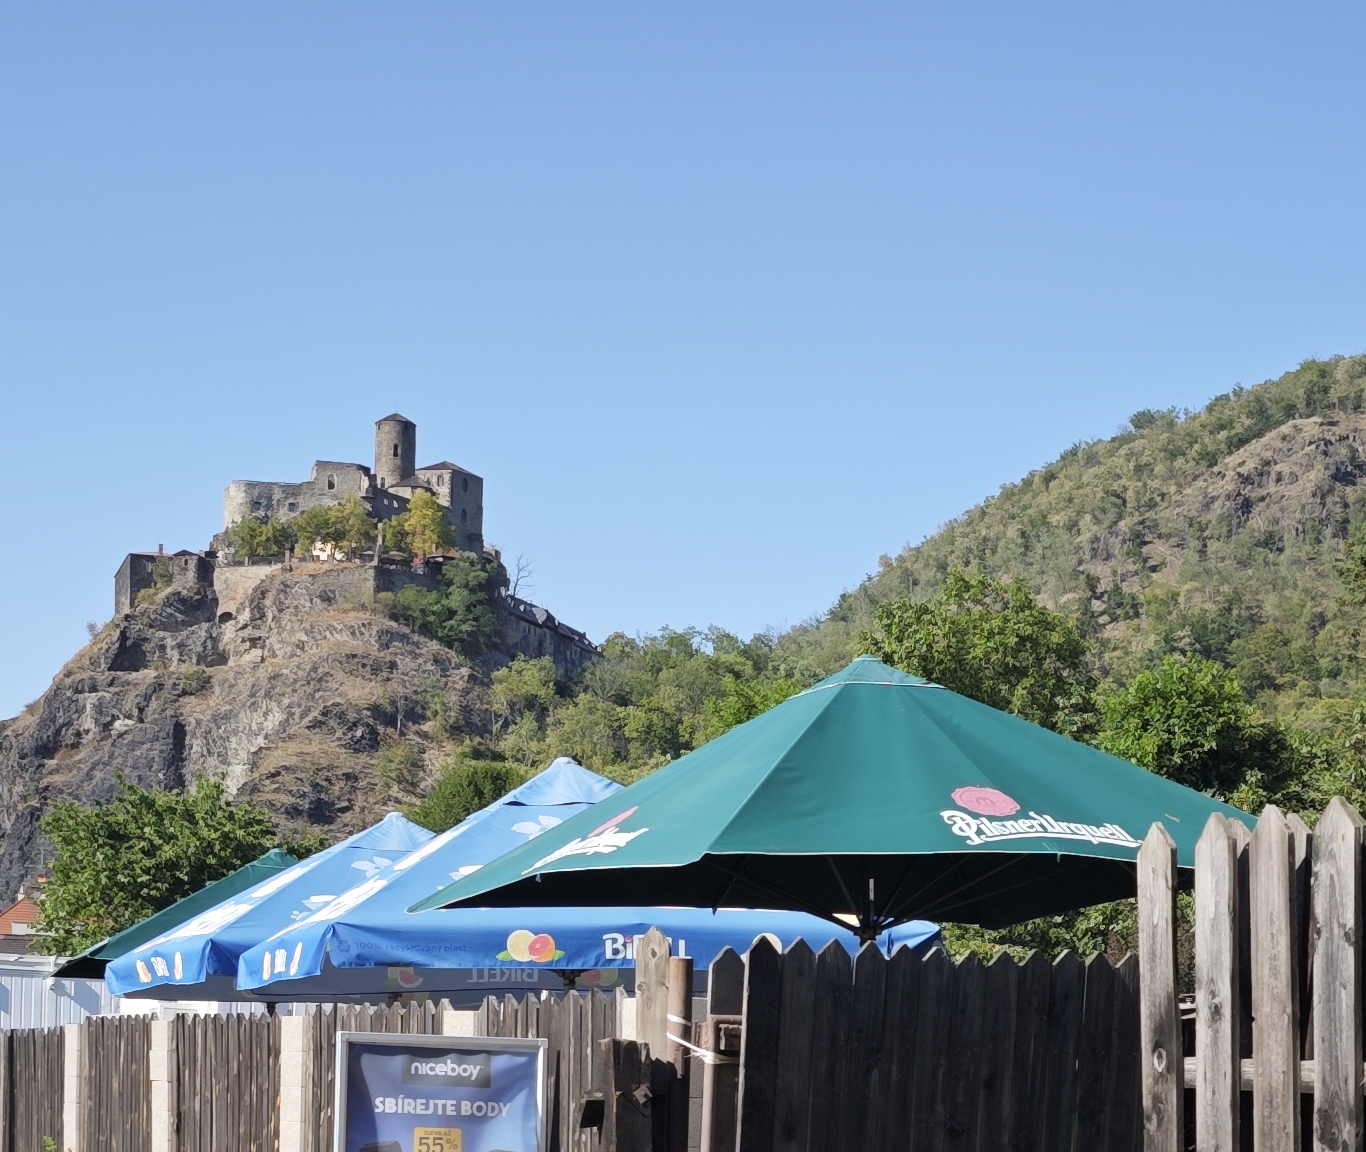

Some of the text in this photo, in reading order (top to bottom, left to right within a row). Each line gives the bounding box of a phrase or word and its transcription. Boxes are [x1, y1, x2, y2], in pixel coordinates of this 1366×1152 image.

[940, 810, 1137, 845] Pilsner Urquell
[355, 941, 381, 950] 100%
[443, 943, 468, 953] plast
[410, 1059, 480, 1081] niceboy
[374, 1095, 512, 1118] SBÍREJTE BODY
